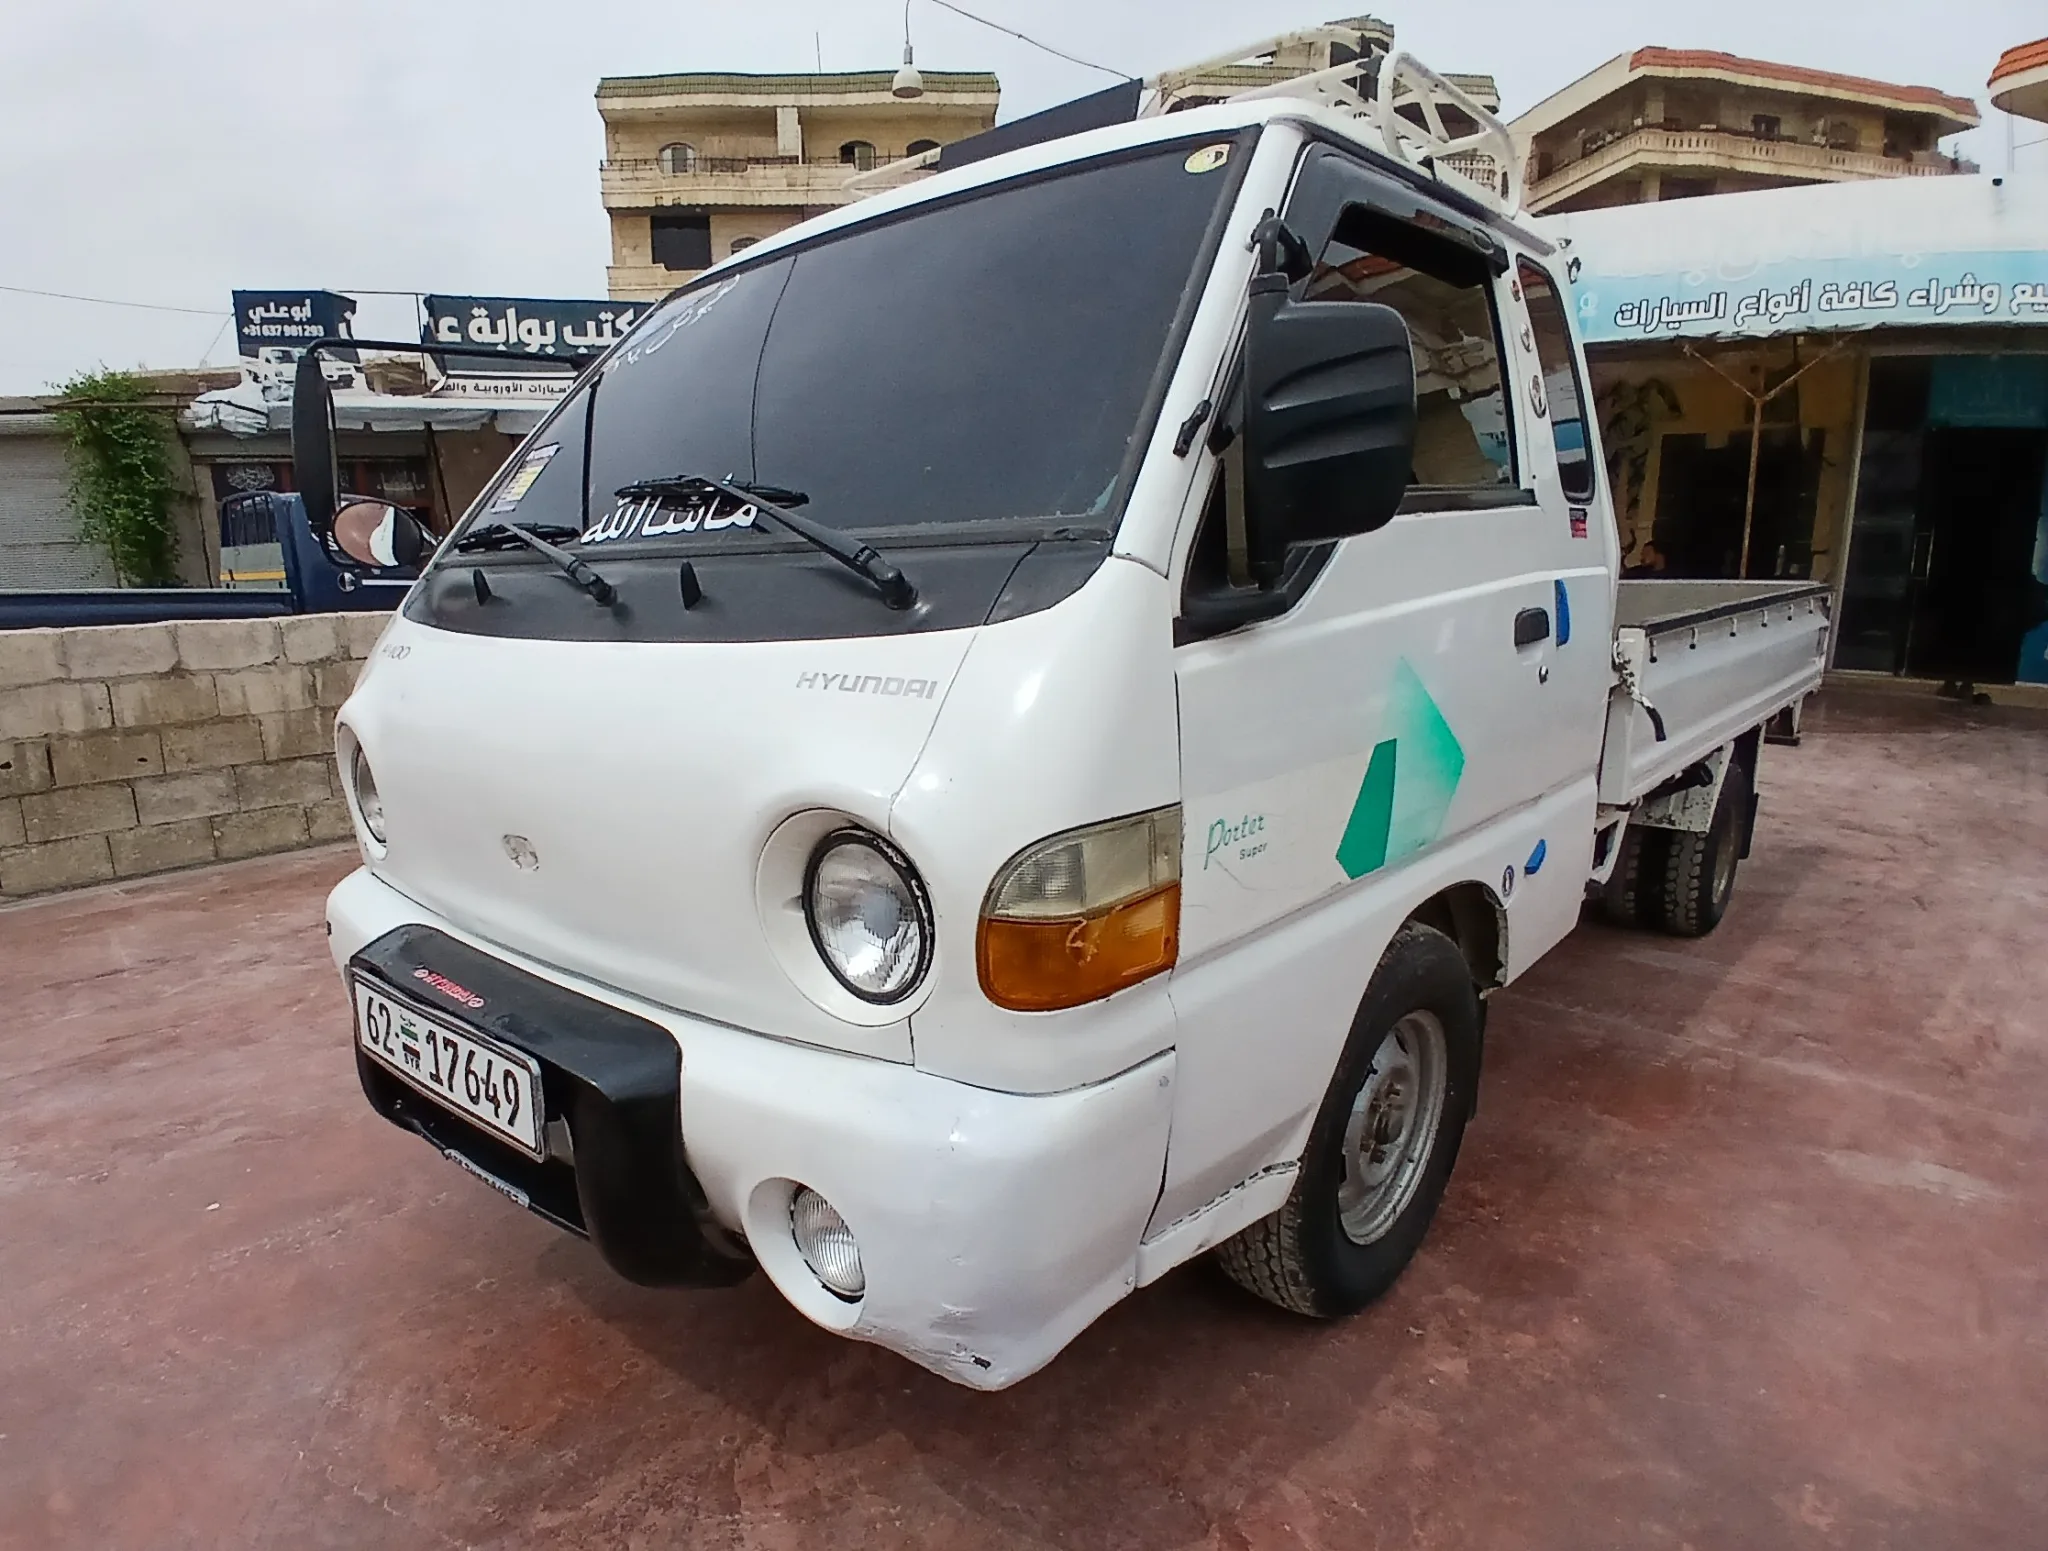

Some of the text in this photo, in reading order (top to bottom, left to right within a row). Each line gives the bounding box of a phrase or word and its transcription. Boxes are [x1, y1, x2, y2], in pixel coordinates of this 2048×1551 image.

[248, 301, 290, 324] علي
[1614, 272, 2048, 334] يع وشراء كافة أنواع السيارات
[468, 306, 556, 354] بوابة
[563, 308, 635, 354] كتب
[795, 671, 938, 700] HYUNDAI
[1203, 814, 1265, 871] Porter
[425, 1029, 520, 1128] 17649
